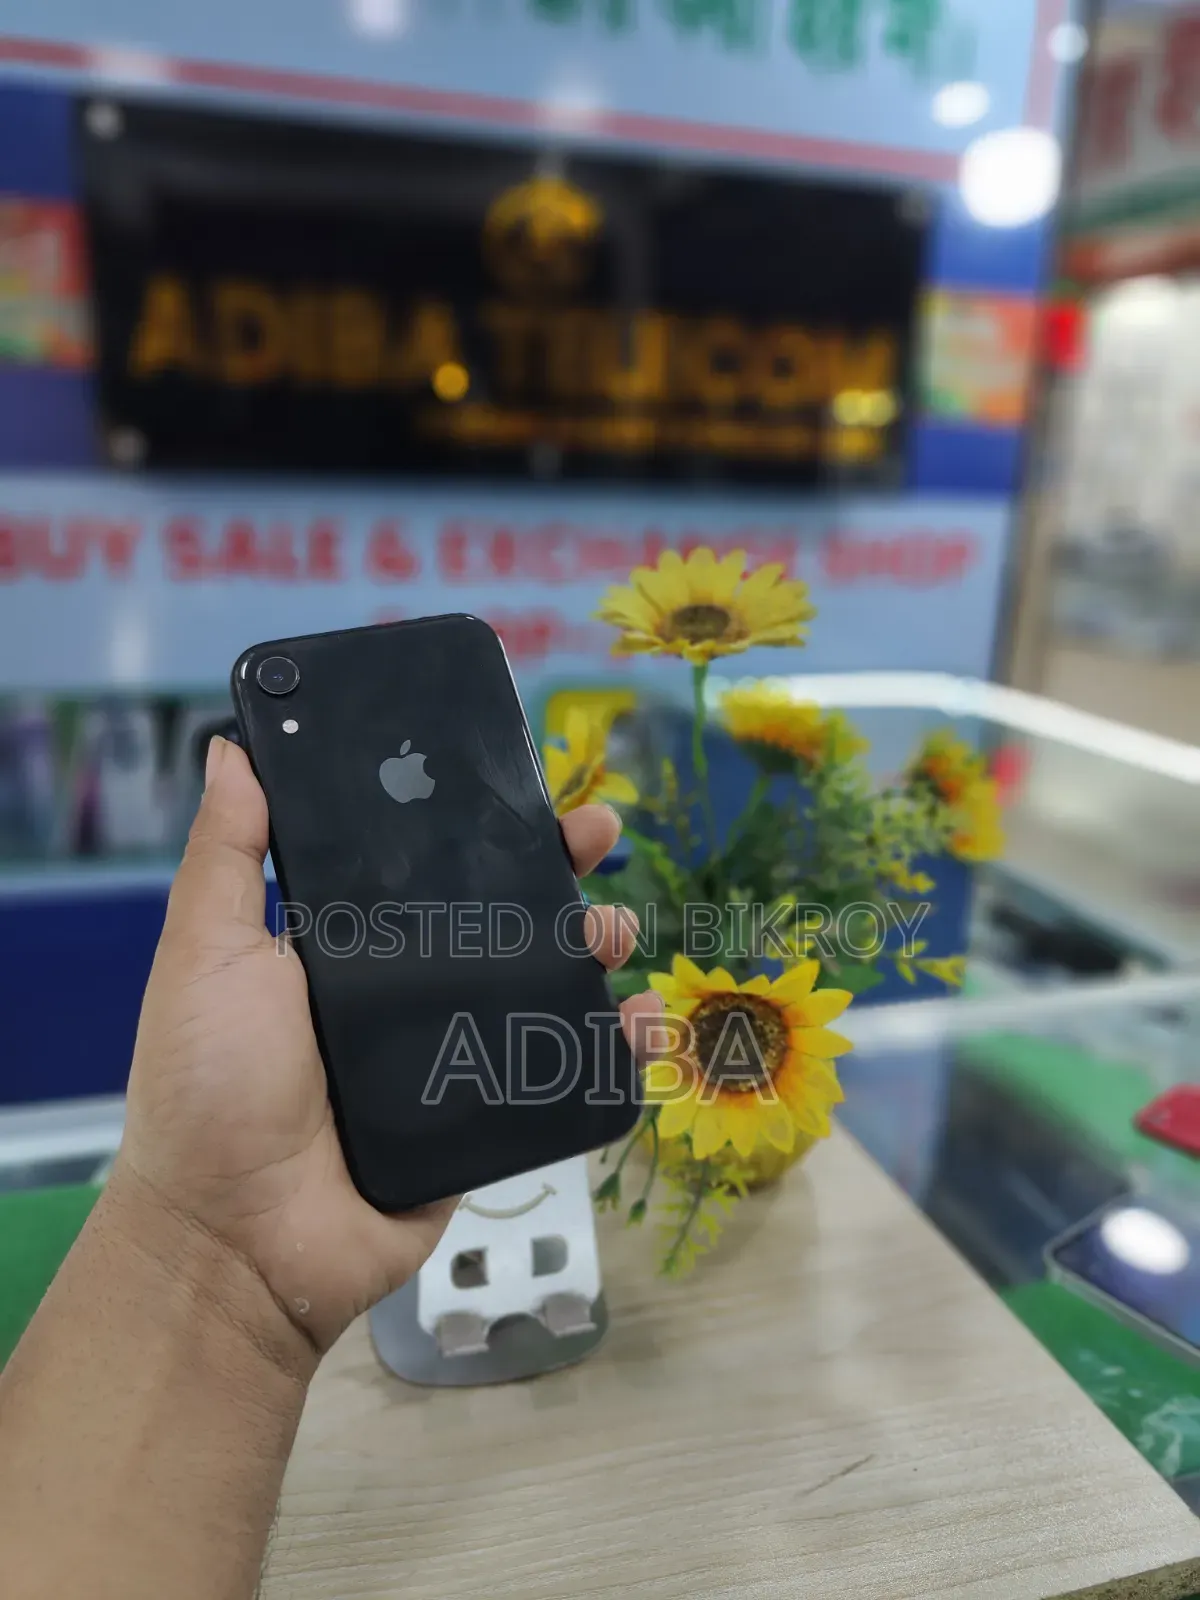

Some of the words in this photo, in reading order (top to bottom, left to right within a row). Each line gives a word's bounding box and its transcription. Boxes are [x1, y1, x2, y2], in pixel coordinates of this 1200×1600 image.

[130, 272, 460, 386] ADIBA
[0, 515, 140, 582] BUY
[163, 515, 344, 582] SALE
[366, 520, 420, 582] &
